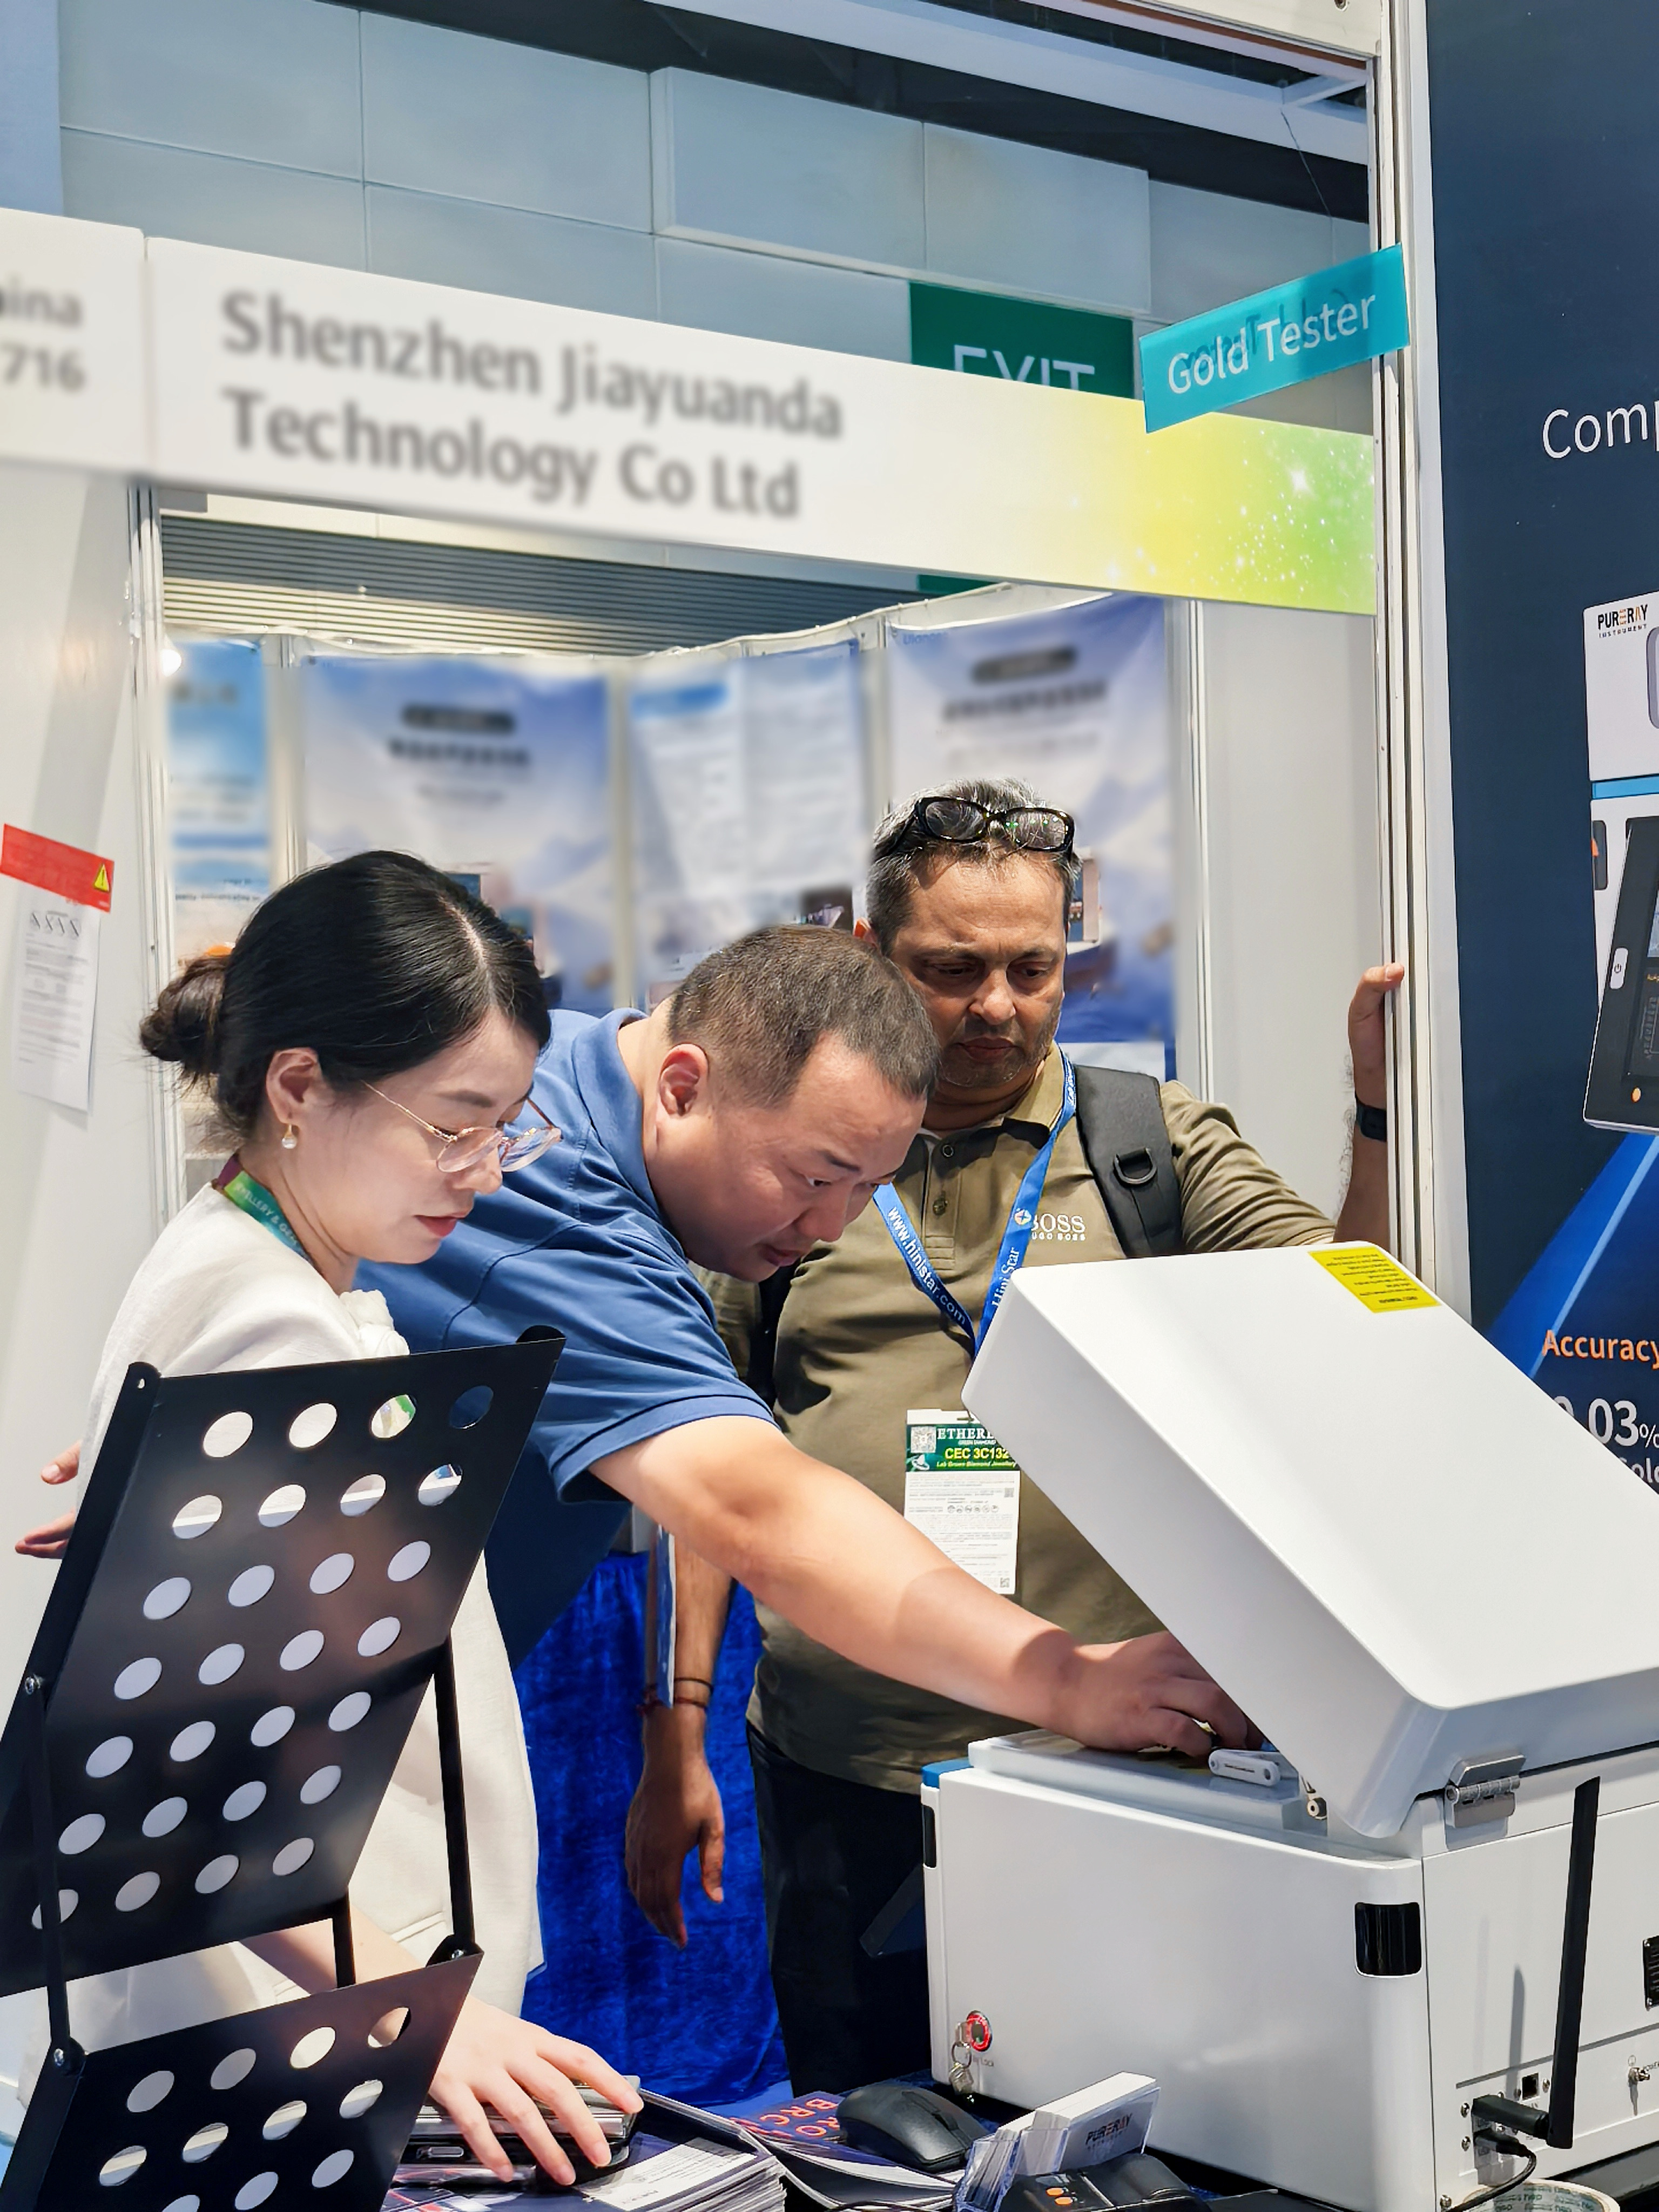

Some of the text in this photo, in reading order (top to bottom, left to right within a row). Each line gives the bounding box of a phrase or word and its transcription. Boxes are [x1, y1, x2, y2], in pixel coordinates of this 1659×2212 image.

[0, 277, 84, 327] ina
[222, 289, 842, 439] Shenzhen Jiayuanda
[1168, 294, 1376, 394] Gold Tester
[221, 387, 799, 520] Technology Co Ltd
[888, 1206, 966, 1325] www.hinistar.com
[1001, 1246, 1020, 1274] Star
[1542, 1330, 1659, 1370] Accuracy
[945, 1447, 971, 1459] CEC
